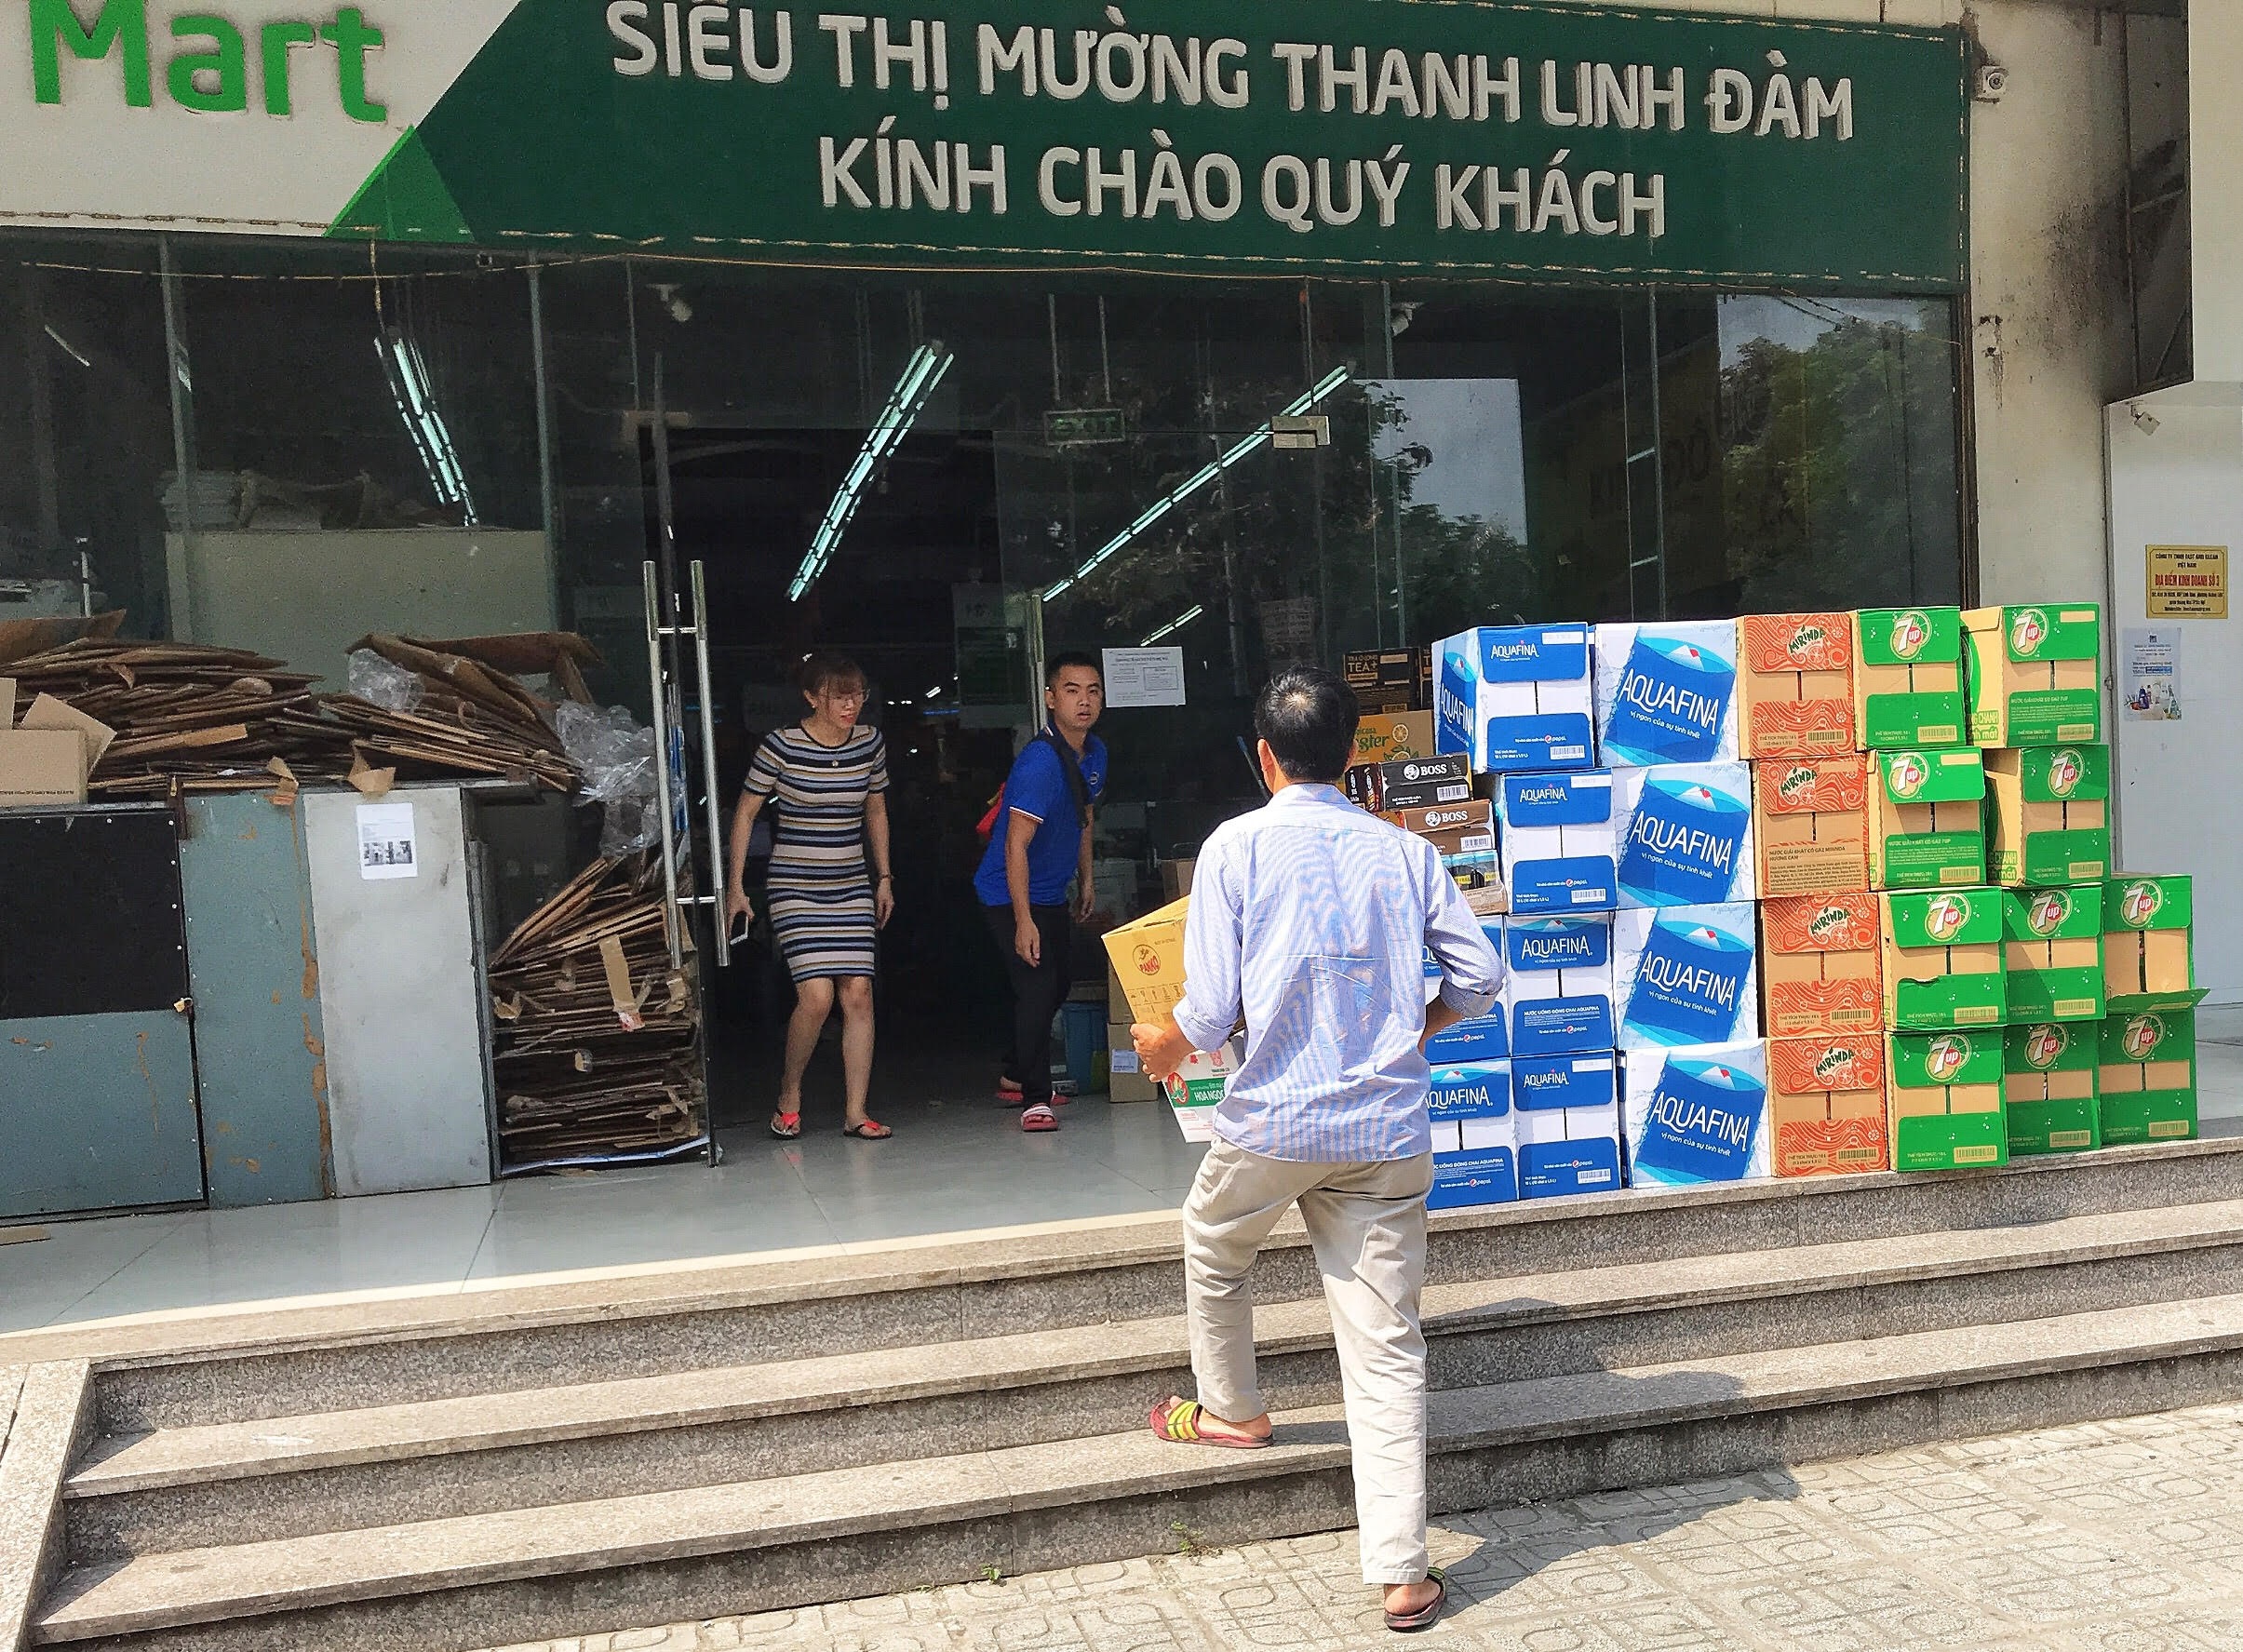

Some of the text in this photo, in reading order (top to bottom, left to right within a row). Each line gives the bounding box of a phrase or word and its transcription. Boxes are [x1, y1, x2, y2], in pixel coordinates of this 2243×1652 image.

[27, 0, 387, 123] Mart
[818, 14, 948, 111] THỊ
[976, 6, 1249, 109] MƯỜNG
[1271, 43, 1520, 122] THANH
[1540, 60, 1685, 131] LINH
[1704, 49, 1854, 141] ĐÀM
[819, 115, 1665, 238] KÍNH CHÀO QUÝ KHÁCH
[1491, 642, 1539, 659] AQUAFINA
[1618, 668, 1719, 735] AQUAFINA
[1420, 764, 1447, 775] BOSS
[1520, 787, 1567, 802] AQUAFINA
[1442, 811, 1468, 823] BOSS
[1629, 811, 1732, 874] AQUAFINA
[1522, 935, 1590, 960] AQUAFINA
[1638, 951, 1736, 1011] AQUAFINA
[1524, 1071, 1569, 1088] AQUAFINA
[1649, 1091, 1750, 1152] AQUAFINA
